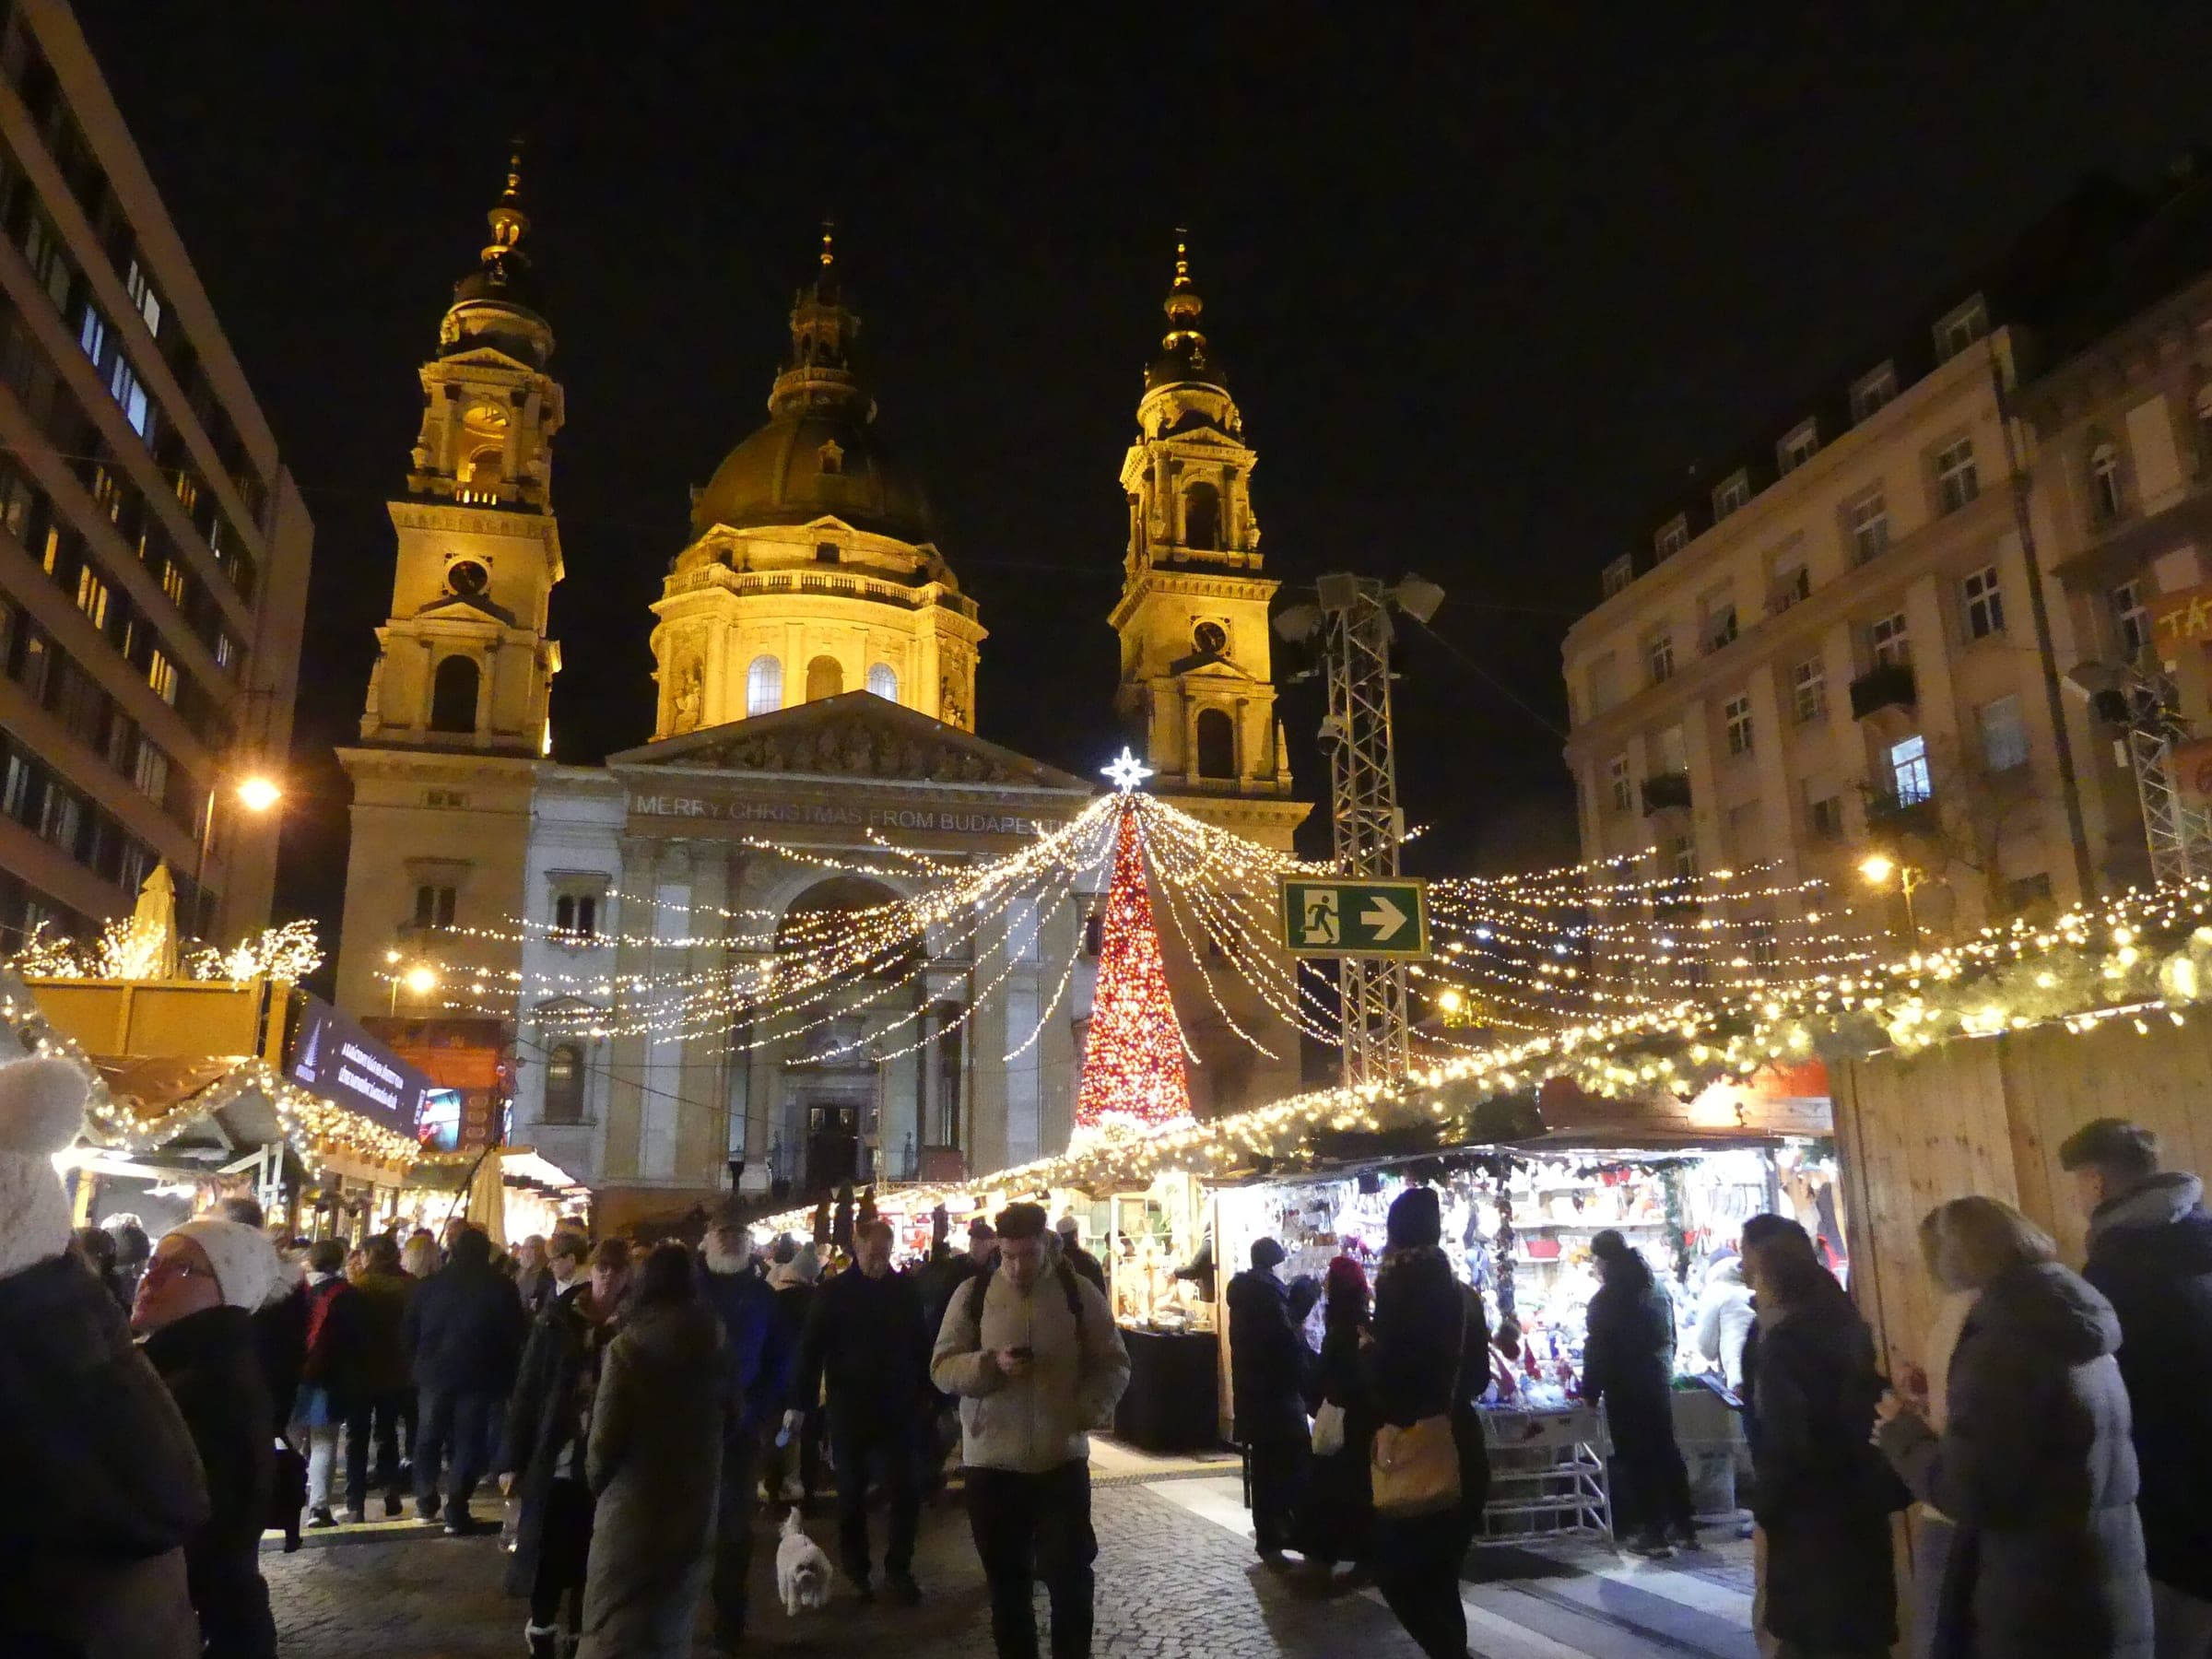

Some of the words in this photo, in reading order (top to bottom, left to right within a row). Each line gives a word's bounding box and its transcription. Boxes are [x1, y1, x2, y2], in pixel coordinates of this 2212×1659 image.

[637, 795, 719, 818] MERRY
[729, 800, 863, 825] CHRISTMAS
[869, 809, 934, 829] FROM
